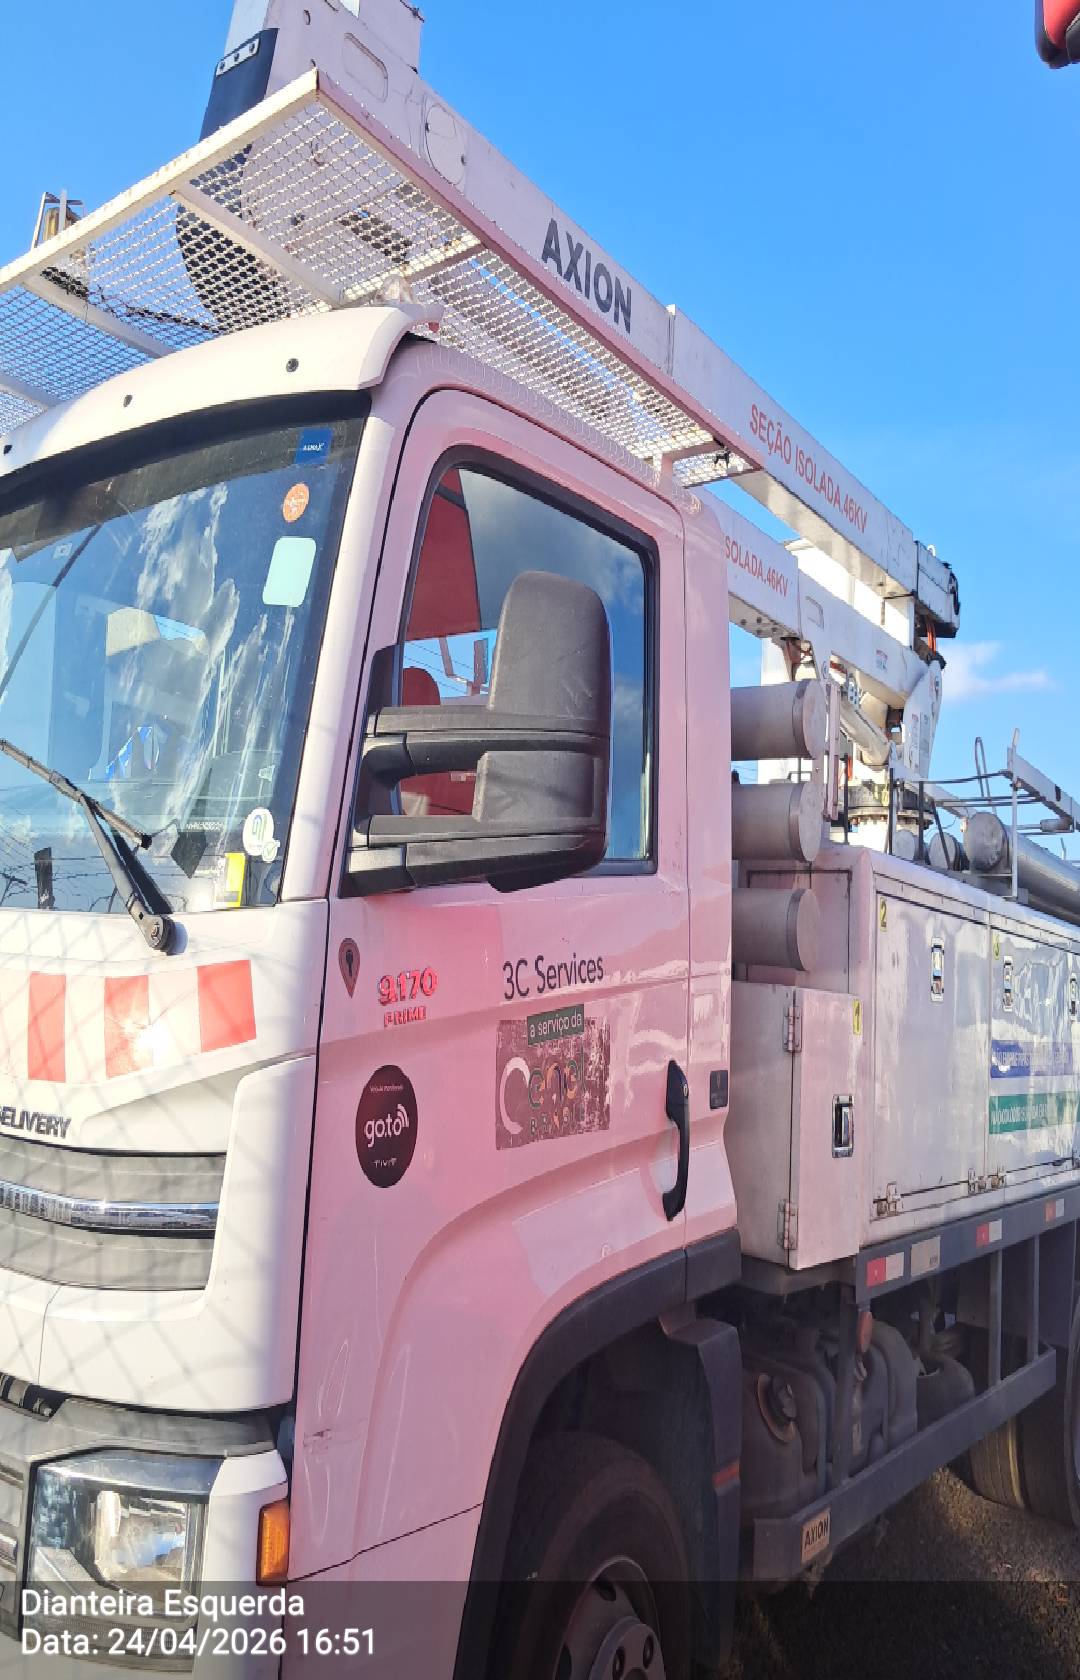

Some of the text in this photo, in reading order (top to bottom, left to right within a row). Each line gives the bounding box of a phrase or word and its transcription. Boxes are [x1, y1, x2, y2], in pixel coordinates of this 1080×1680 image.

[541, 218, 631, 333] AXION
[750, 404, 791, 464] SEÇÃO
[724, 535, 788, 597] SOLADA.46KV
[880, 900, 887, 928] 2
[503, 952, 604, 1000] 3C Services
[384, 1006, 426, 1028] PRIME
[529, 1007, 583, 1038] a serviço da
[0, 1106, 71, 1139] ELIVERY
[804, 1514, 829, 1550] AXION
